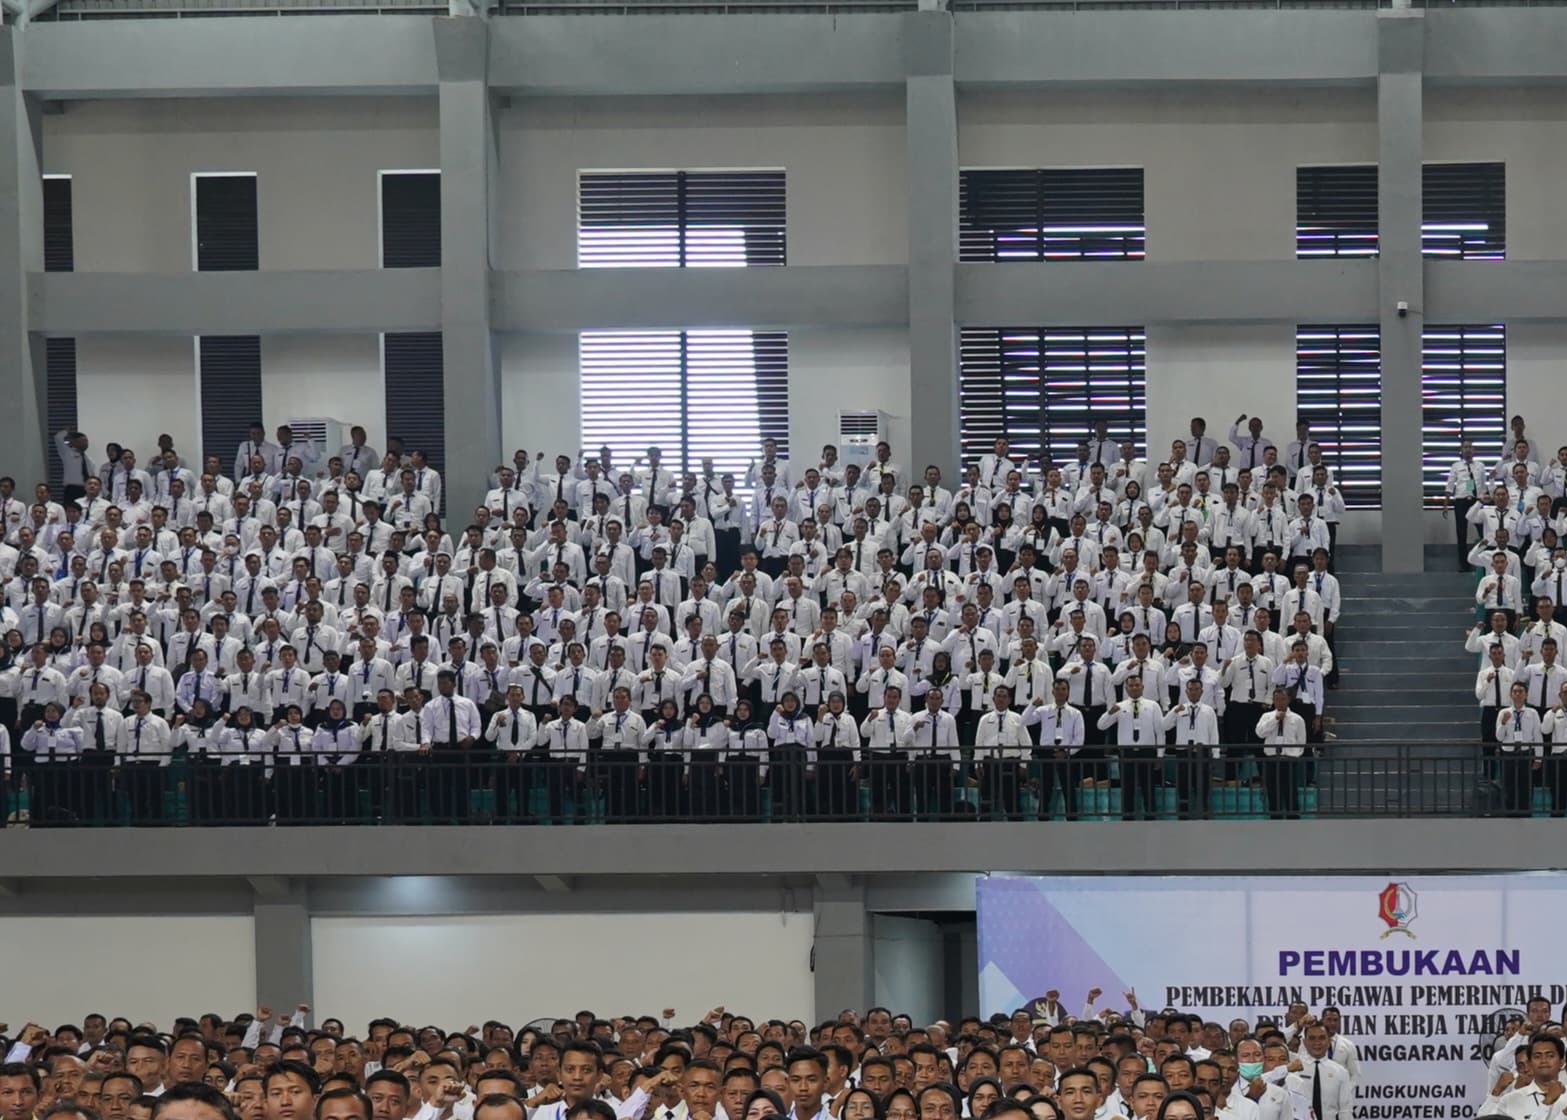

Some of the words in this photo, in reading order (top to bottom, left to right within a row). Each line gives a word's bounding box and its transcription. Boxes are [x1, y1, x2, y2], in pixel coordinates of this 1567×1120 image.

[1278, 950, 1520, 976] PEMBUKAAN
[1166, 985, 1302, 1007] PEMBEKALAN
[1310, 985, 1403, 1007] PEGAWAI
[1411, 985, 1542, 1006] PEMERINTAH
[1384, 1014, 1448, 1038] KERJA
[1470, 1044, 1495, 1060] 20
[1355, 1085, 1466, 1099] LINGKUNGAN
